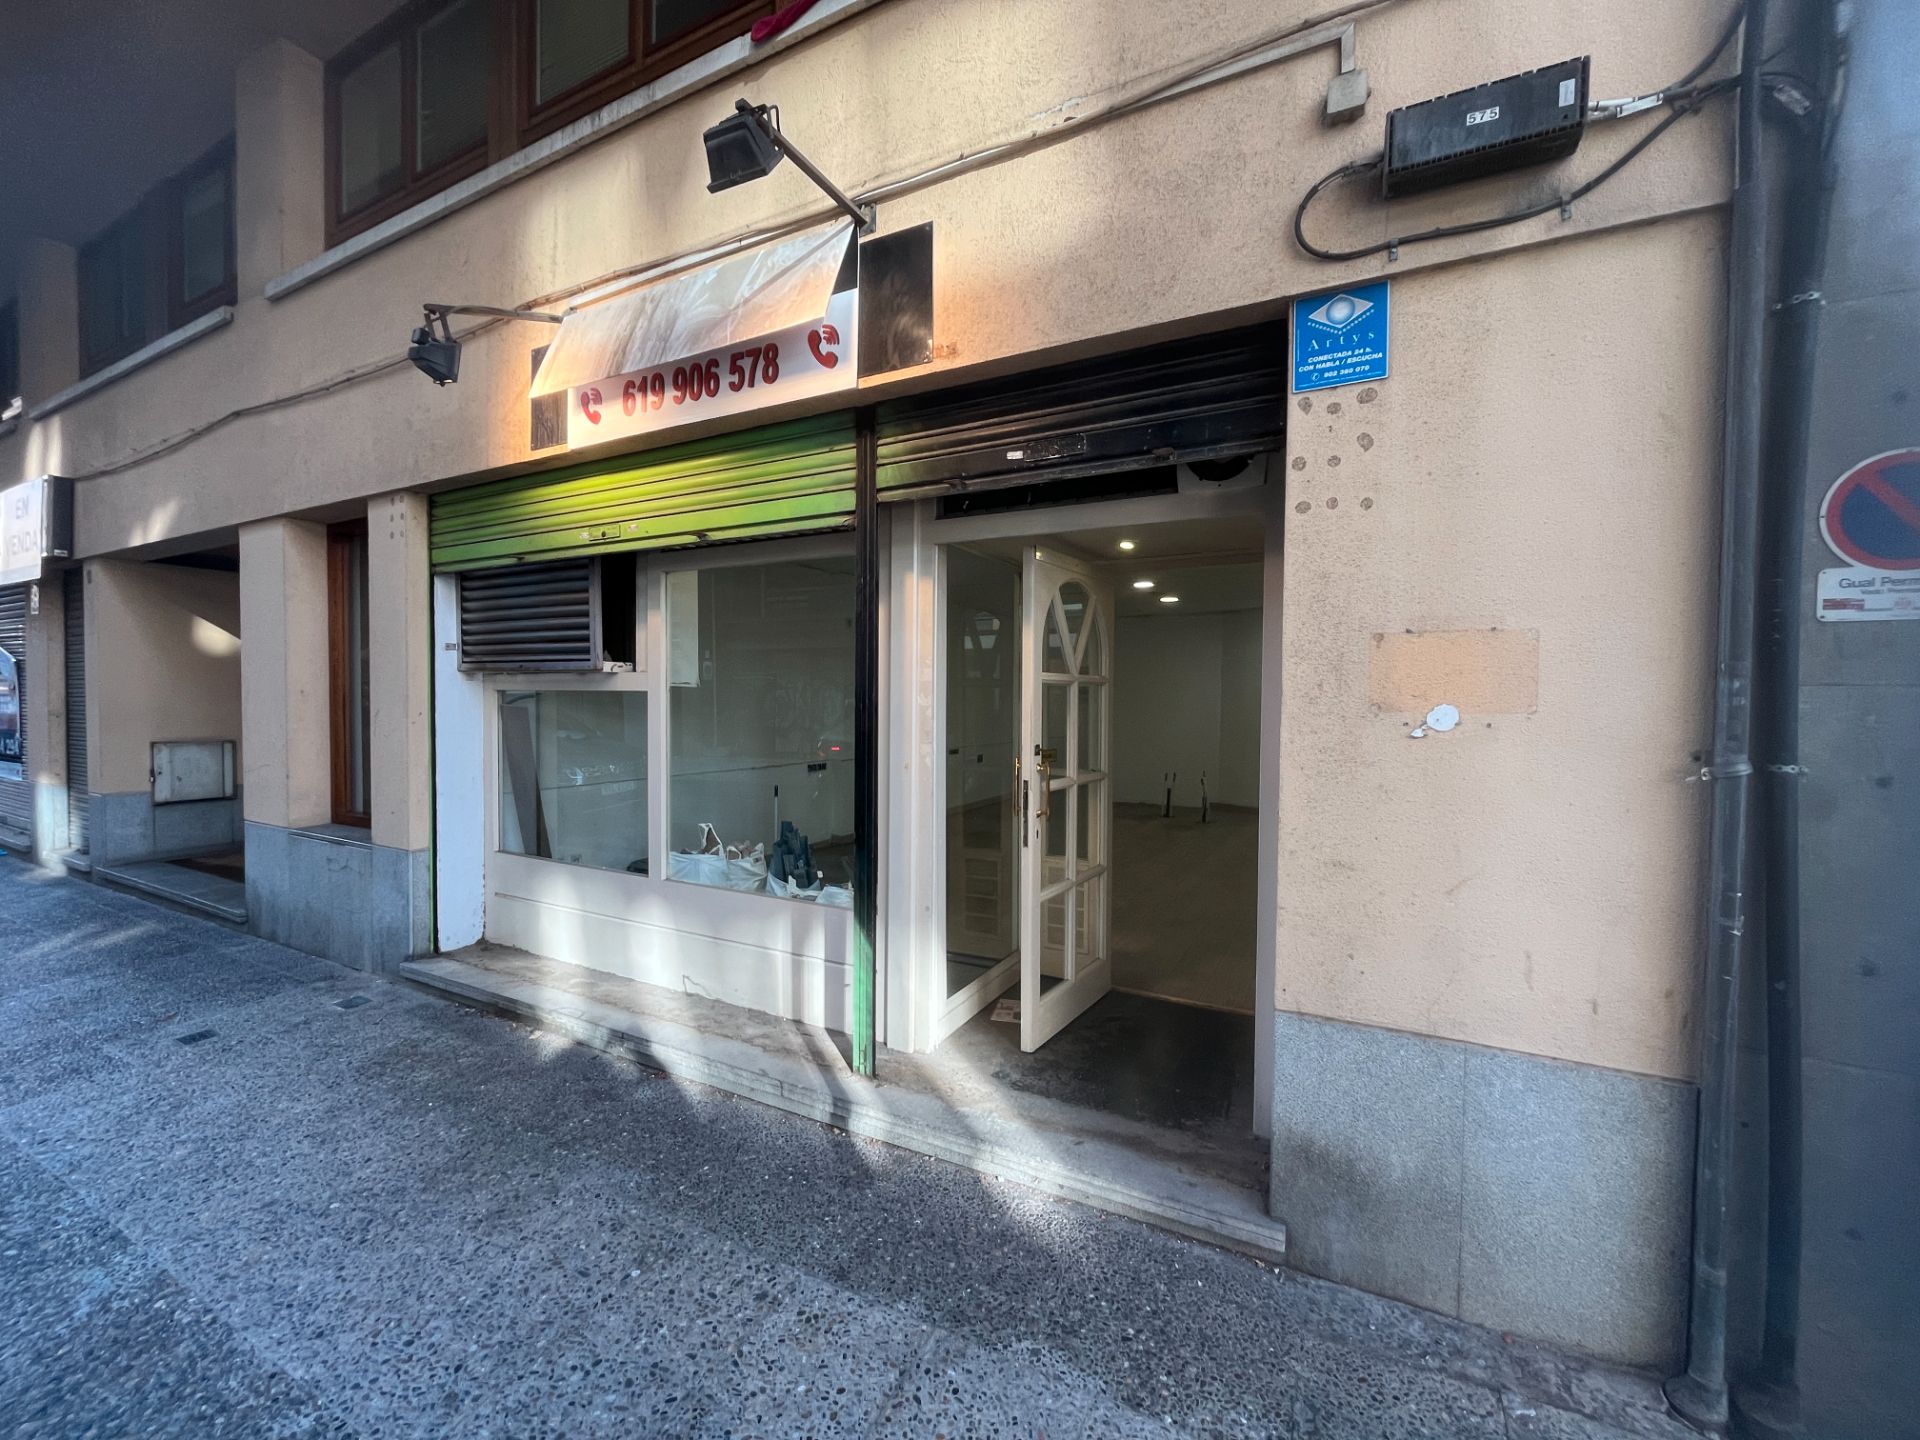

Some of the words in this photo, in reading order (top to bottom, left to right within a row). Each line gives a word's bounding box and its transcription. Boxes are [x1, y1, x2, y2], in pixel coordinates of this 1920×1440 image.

[1468, 108, 1498, 124] 575
[1308, 332, 1375, 351] Artys
[1298, 365, 1314, 373] CON
[1315, 360, 1340, 370] HABLA
[1346, 352, 1383, 364] ESCUCHA
[1307, 350, 1352, 364] CONECTADA
[622, 372, 666, 417] 619
[672, 358, 721, 406] 906
[728, 342, 780, 393] 578
[1839, 577, 1876, 589] Gual
